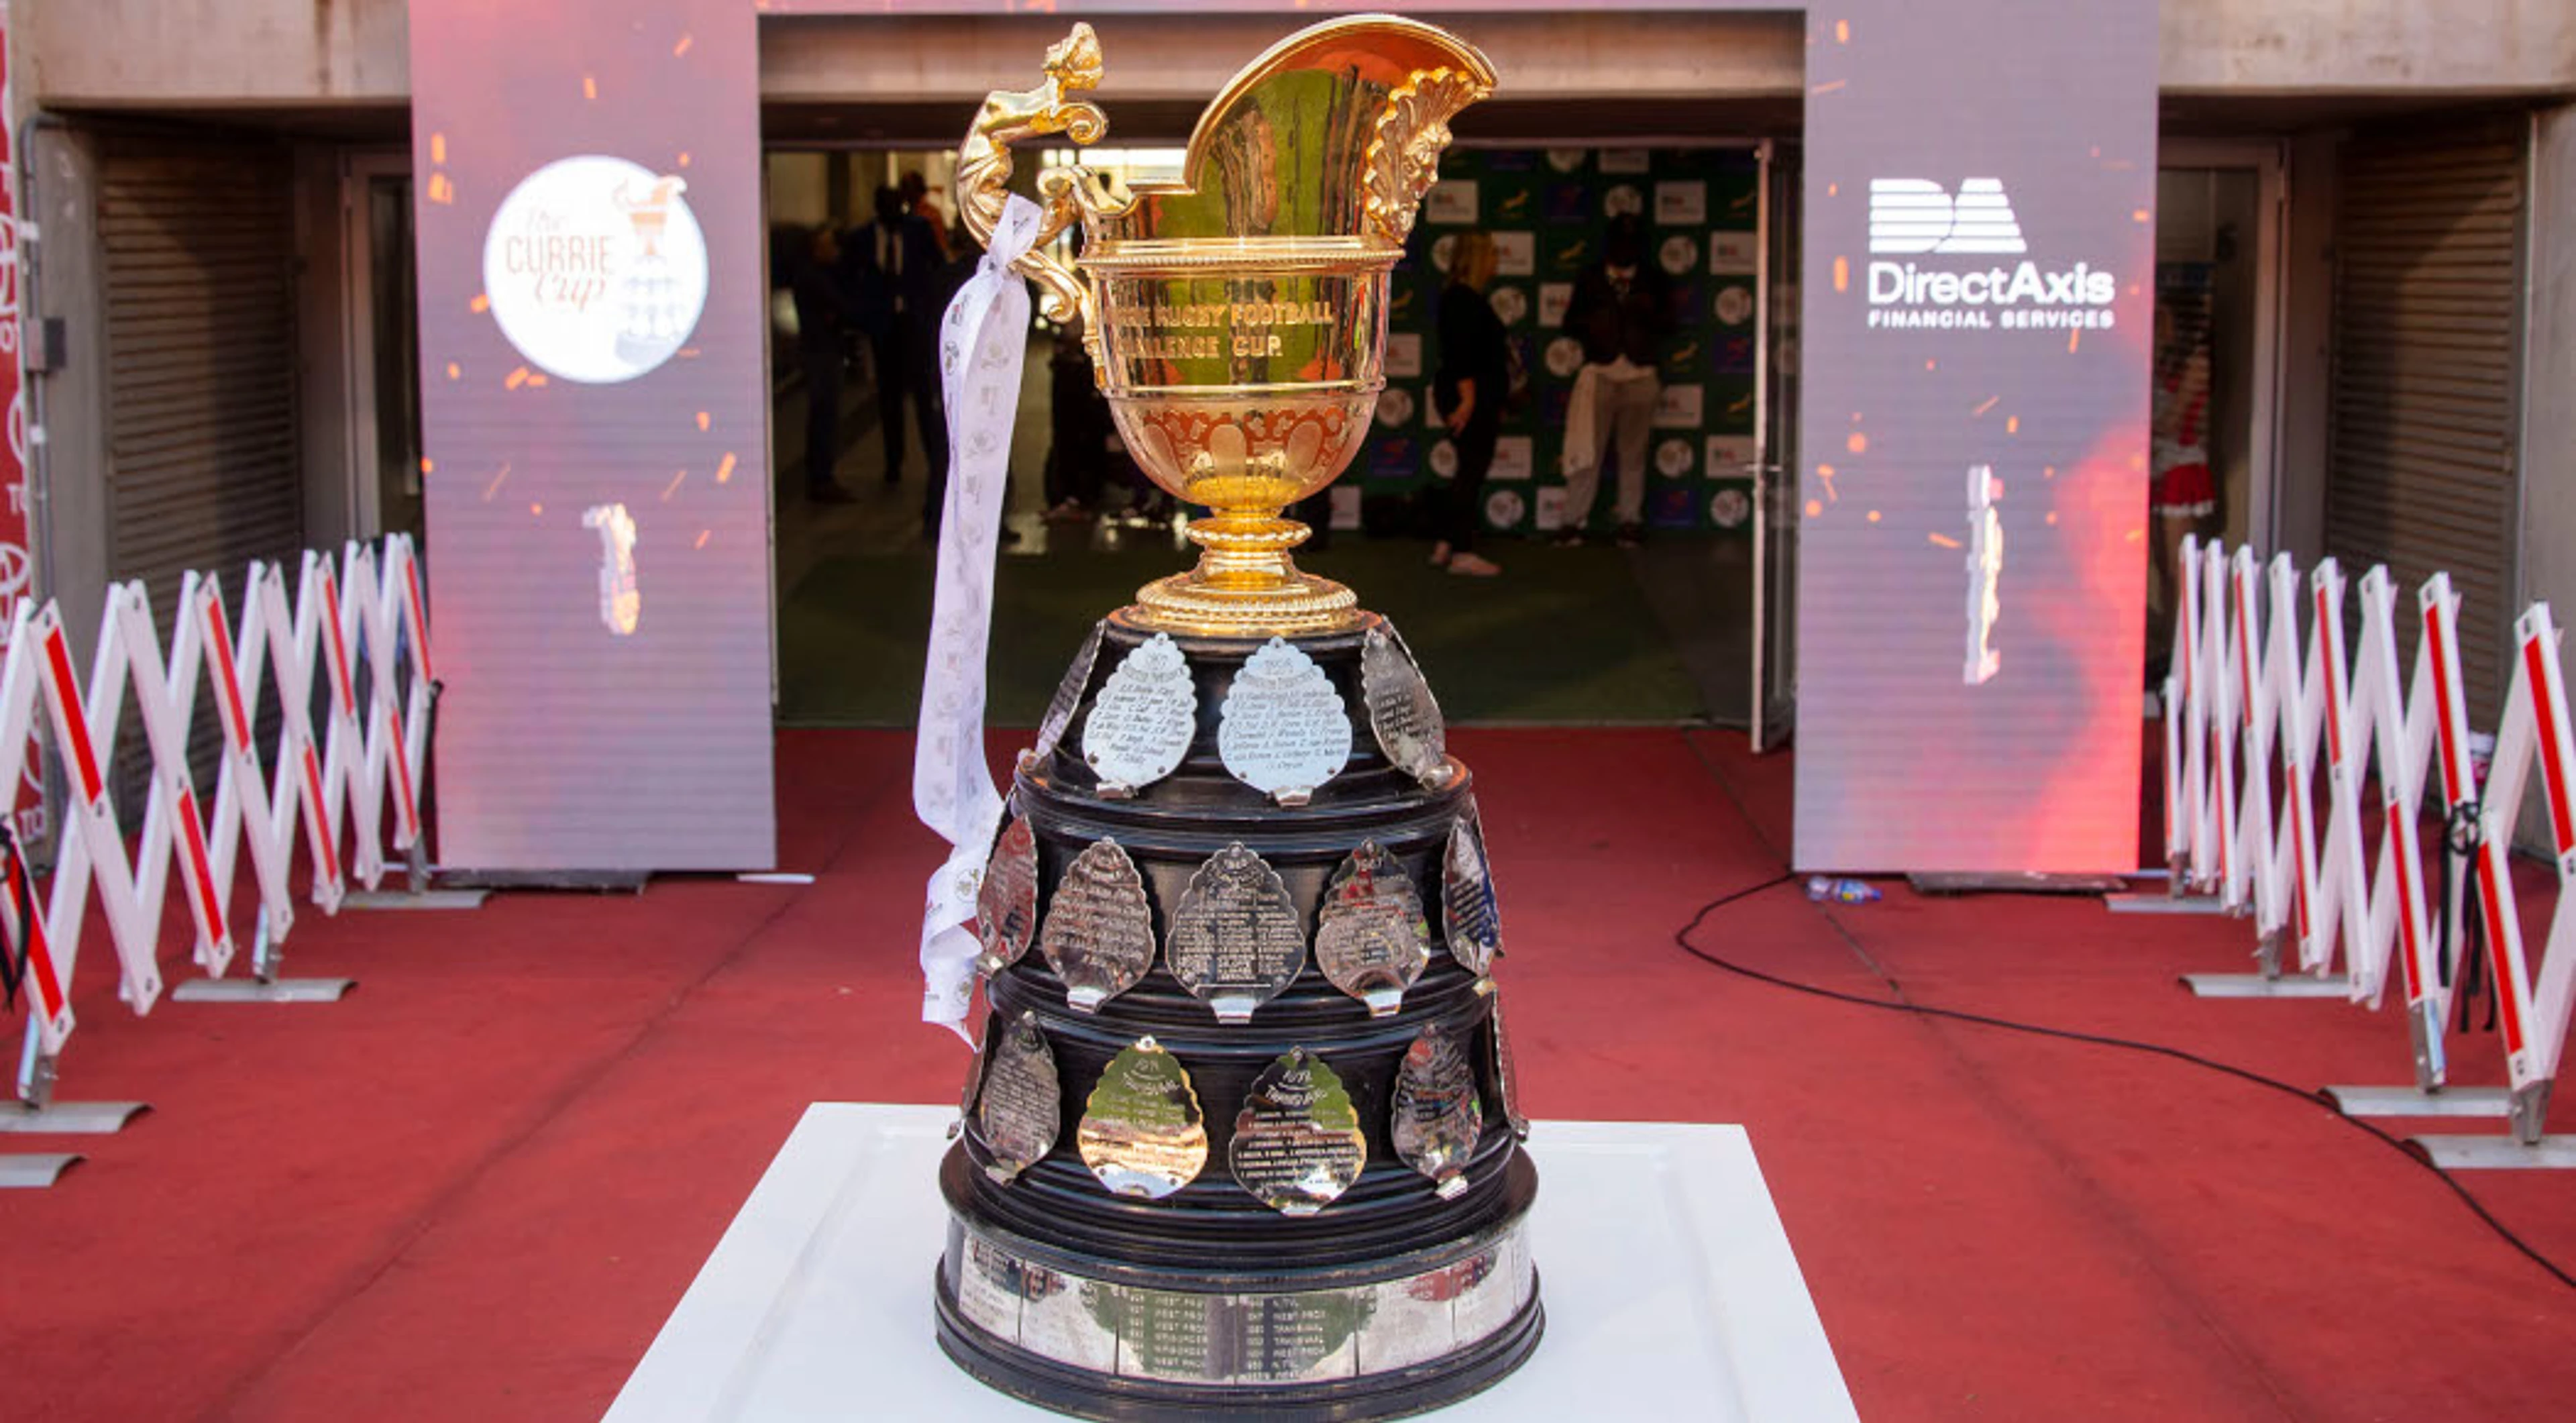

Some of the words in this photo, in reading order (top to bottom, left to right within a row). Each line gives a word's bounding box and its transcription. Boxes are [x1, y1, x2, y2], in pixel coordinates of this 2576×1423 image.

[504, 234, 615, 276] CURRIE
[1868, 261, 2116, 305] DirectAxis
[1154, 305, 1228, 327] RUGBY
[1230, 301, 1334, 326] FOOTBALL
[1868, 309, 1992, 329] FINANCIAL
[2000, 309, 2116, 329] SERVICES
